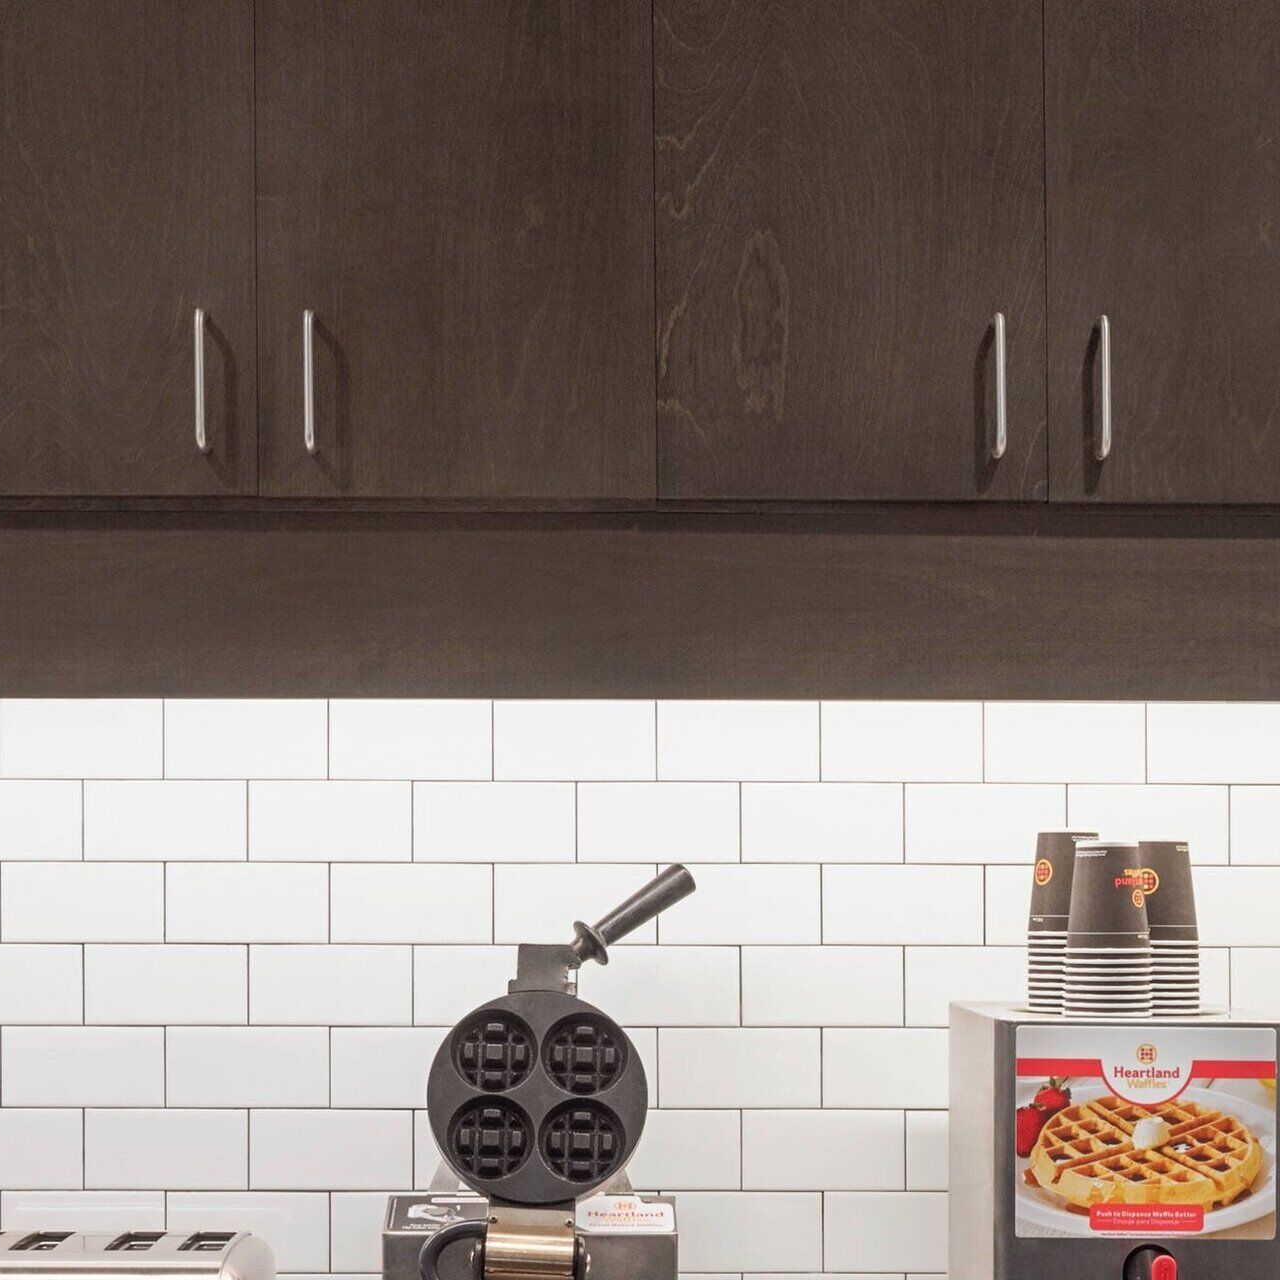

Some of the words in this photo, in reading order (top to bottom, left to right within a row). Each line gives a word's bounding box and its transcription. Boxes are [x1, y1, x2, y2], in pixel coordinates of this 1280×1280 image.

[1114, 1067, 1180, 1079] Heartland
[1127, 1079, 1168, 1089] Waffles
[1121, 1211, 1150, 1219] Dispense
